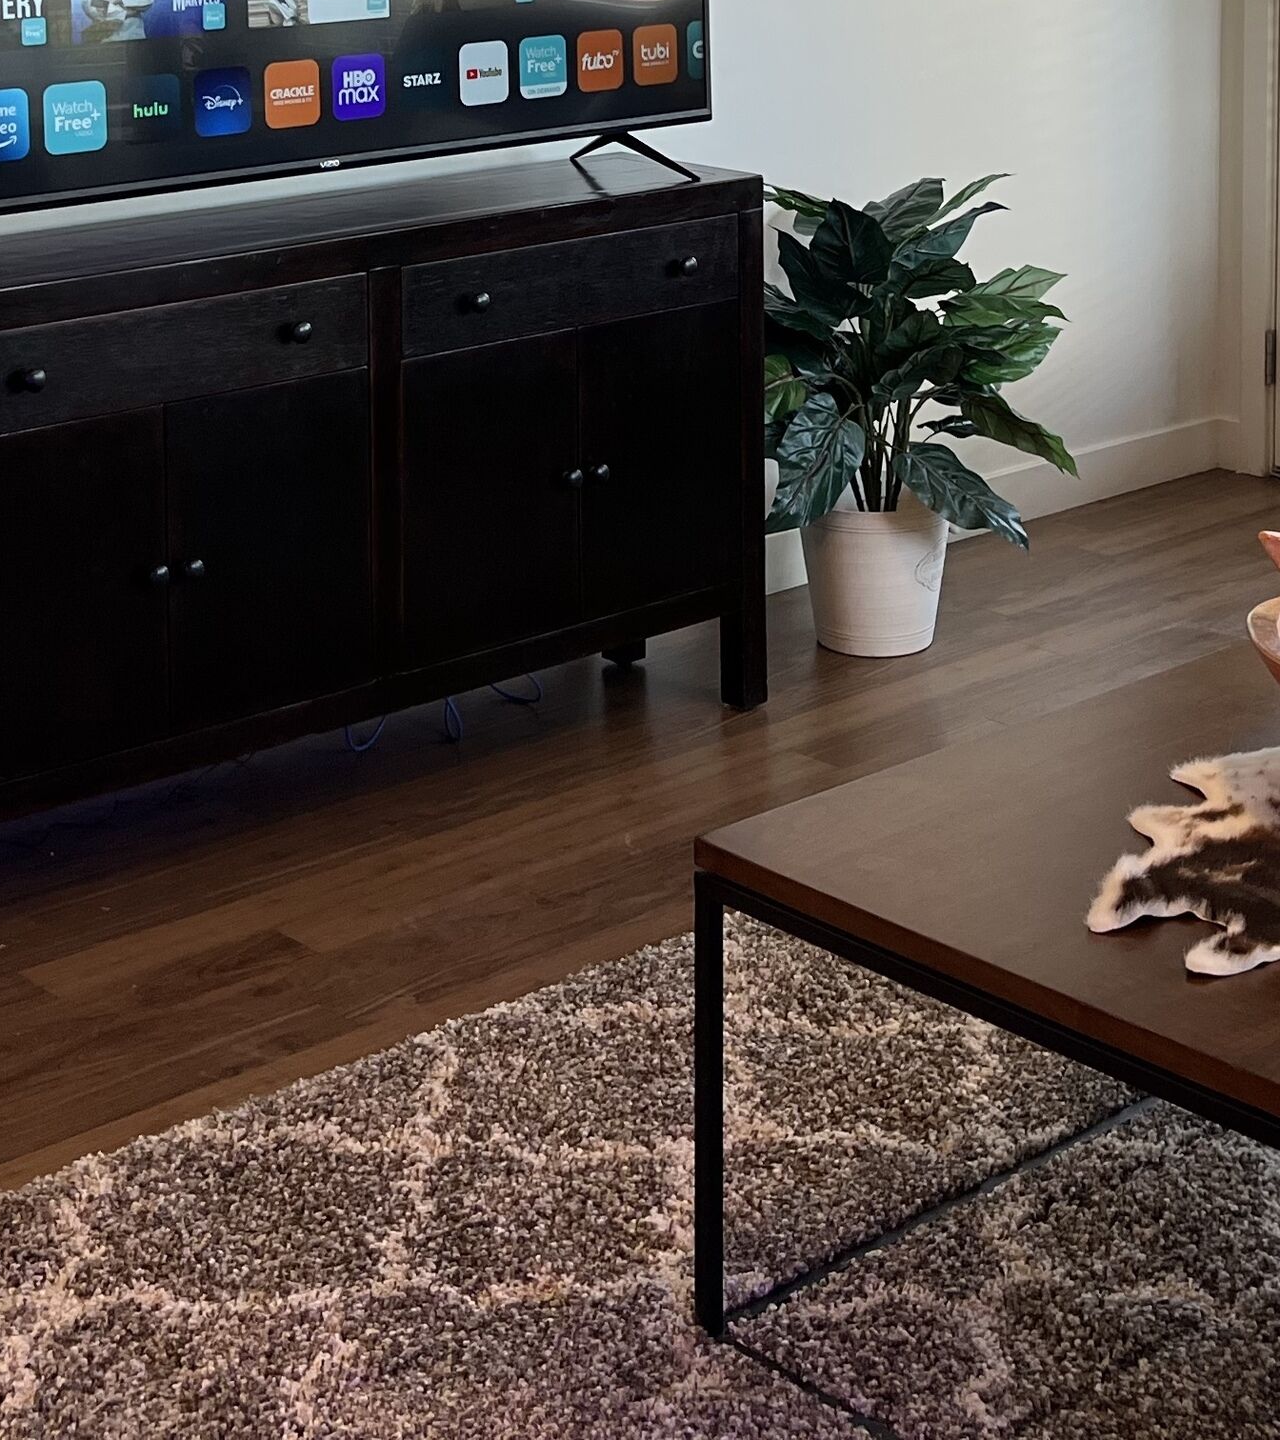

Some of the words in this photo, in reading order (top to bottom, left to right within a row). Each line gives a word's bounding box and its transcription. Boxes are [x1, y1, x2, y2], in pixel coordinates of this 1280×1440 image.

[526, 46, 556, 59] Watch
[641, 42, 670, 61] tubi
[343, 69, 376, 89] HBO
[403, 72, 442, 88] STARZ
[269, 85, 315, 100] CRACKLE
[338, 85, 380, 106] max
[52, 100, 93, 116] Watch
[133, 102, 169, 119] hulu
